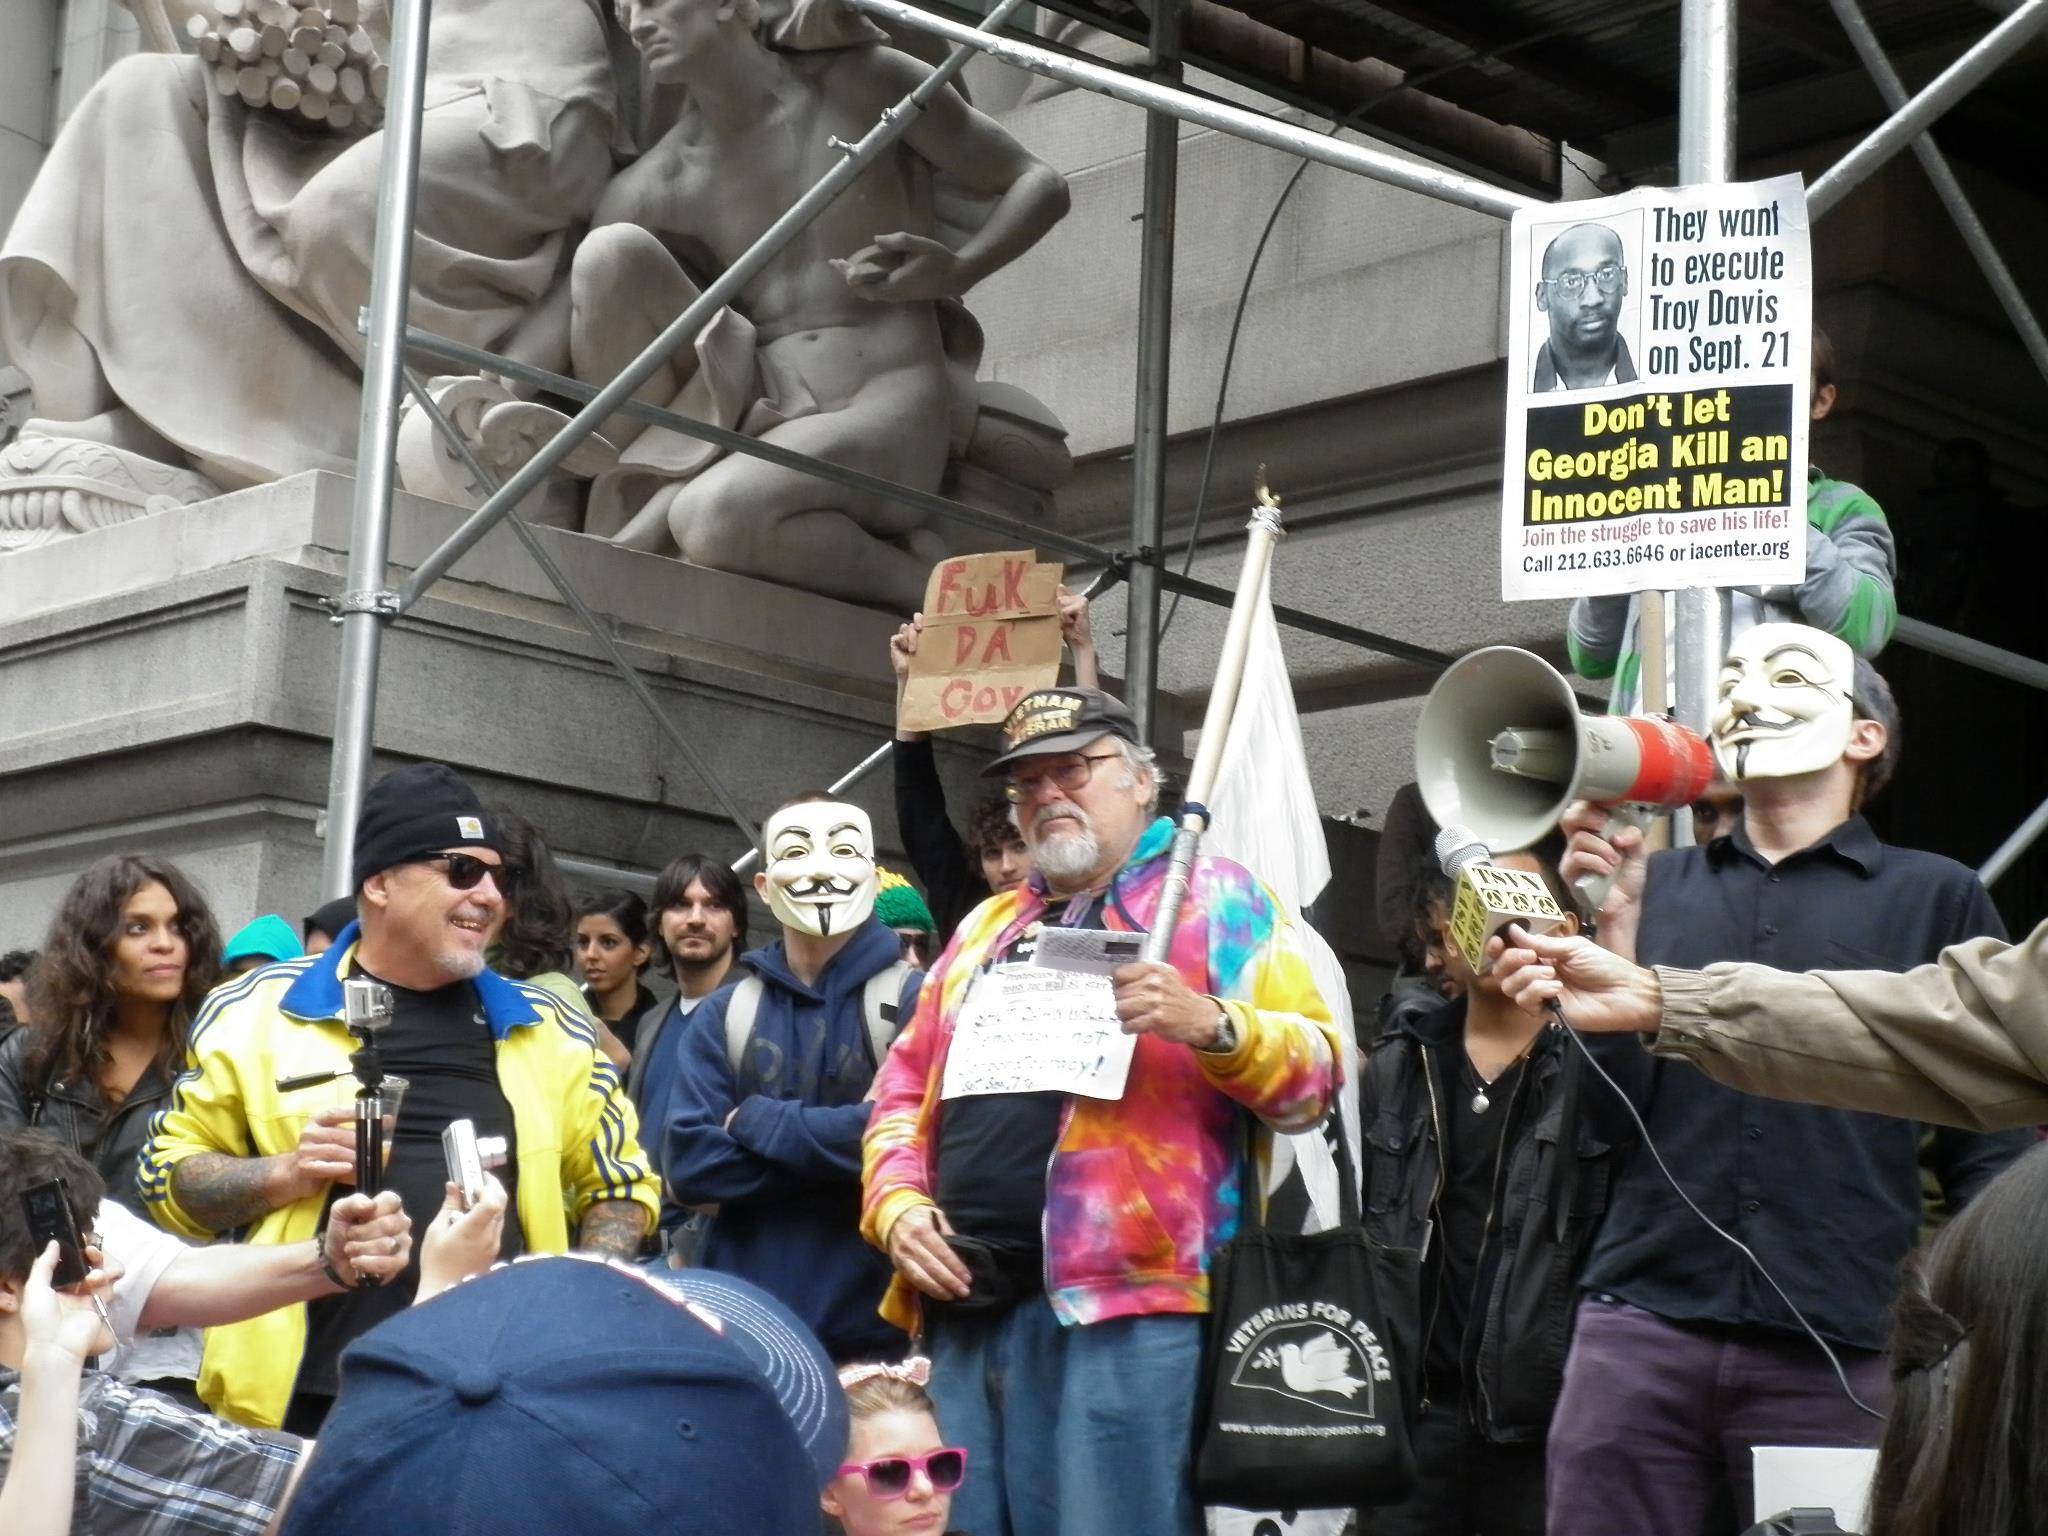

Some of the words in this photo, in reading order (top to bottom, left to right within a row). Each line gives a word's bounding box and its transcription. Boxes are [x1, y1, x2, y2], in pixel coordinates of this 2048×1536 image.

[1653, 207, 1708, 242] They
[1719, 200, 1779, 237] want
[1652, 252, 1674, 287] to
[1685, 246, 1784, 285] execute
[1650, 294, 1699, 333] Troy
[1708, 289, 1778, 326] Davis
[1649, 344, 1678, 375] on
[1688, 334, 1749, 374] Sept.
[1761, 331, 1789, 368] 21
[1584, 395, 1673, 436] Don't
[1683, 389, 1731, 426] let
[1528, 437, 1659, 482] Georgia
[1672, 430, 1729, 468] Kill
[1740, 434, 1788, 463] an
[1531, 477, 1681, 522] Innocent
[1692, 470, 1783, 507] Man!
[1522, 529, 1555, 547] Join
[1560, 525, 1586, 544] the
[1591, 517, 1651, 544] struggle
[1658, 518, 1674, 536] to
[1680, 516, 1717, 535] save
[1722, 511, 1748, 531] his
[1753, 509, 1789, 530] life!
[1523, 554, 1553, 573] Call
[1557, 544, 1664, 571] 212.633.6646
[1670, 550, 1686, 561] or
[1690, 540, 1790, 561] iacenter.org
[1226, 1303, 1309, 1353] VETERANS
[1312, 1301, 1352, 1327] FOR
[1351, 1320, 1392, 1382] PEACE
